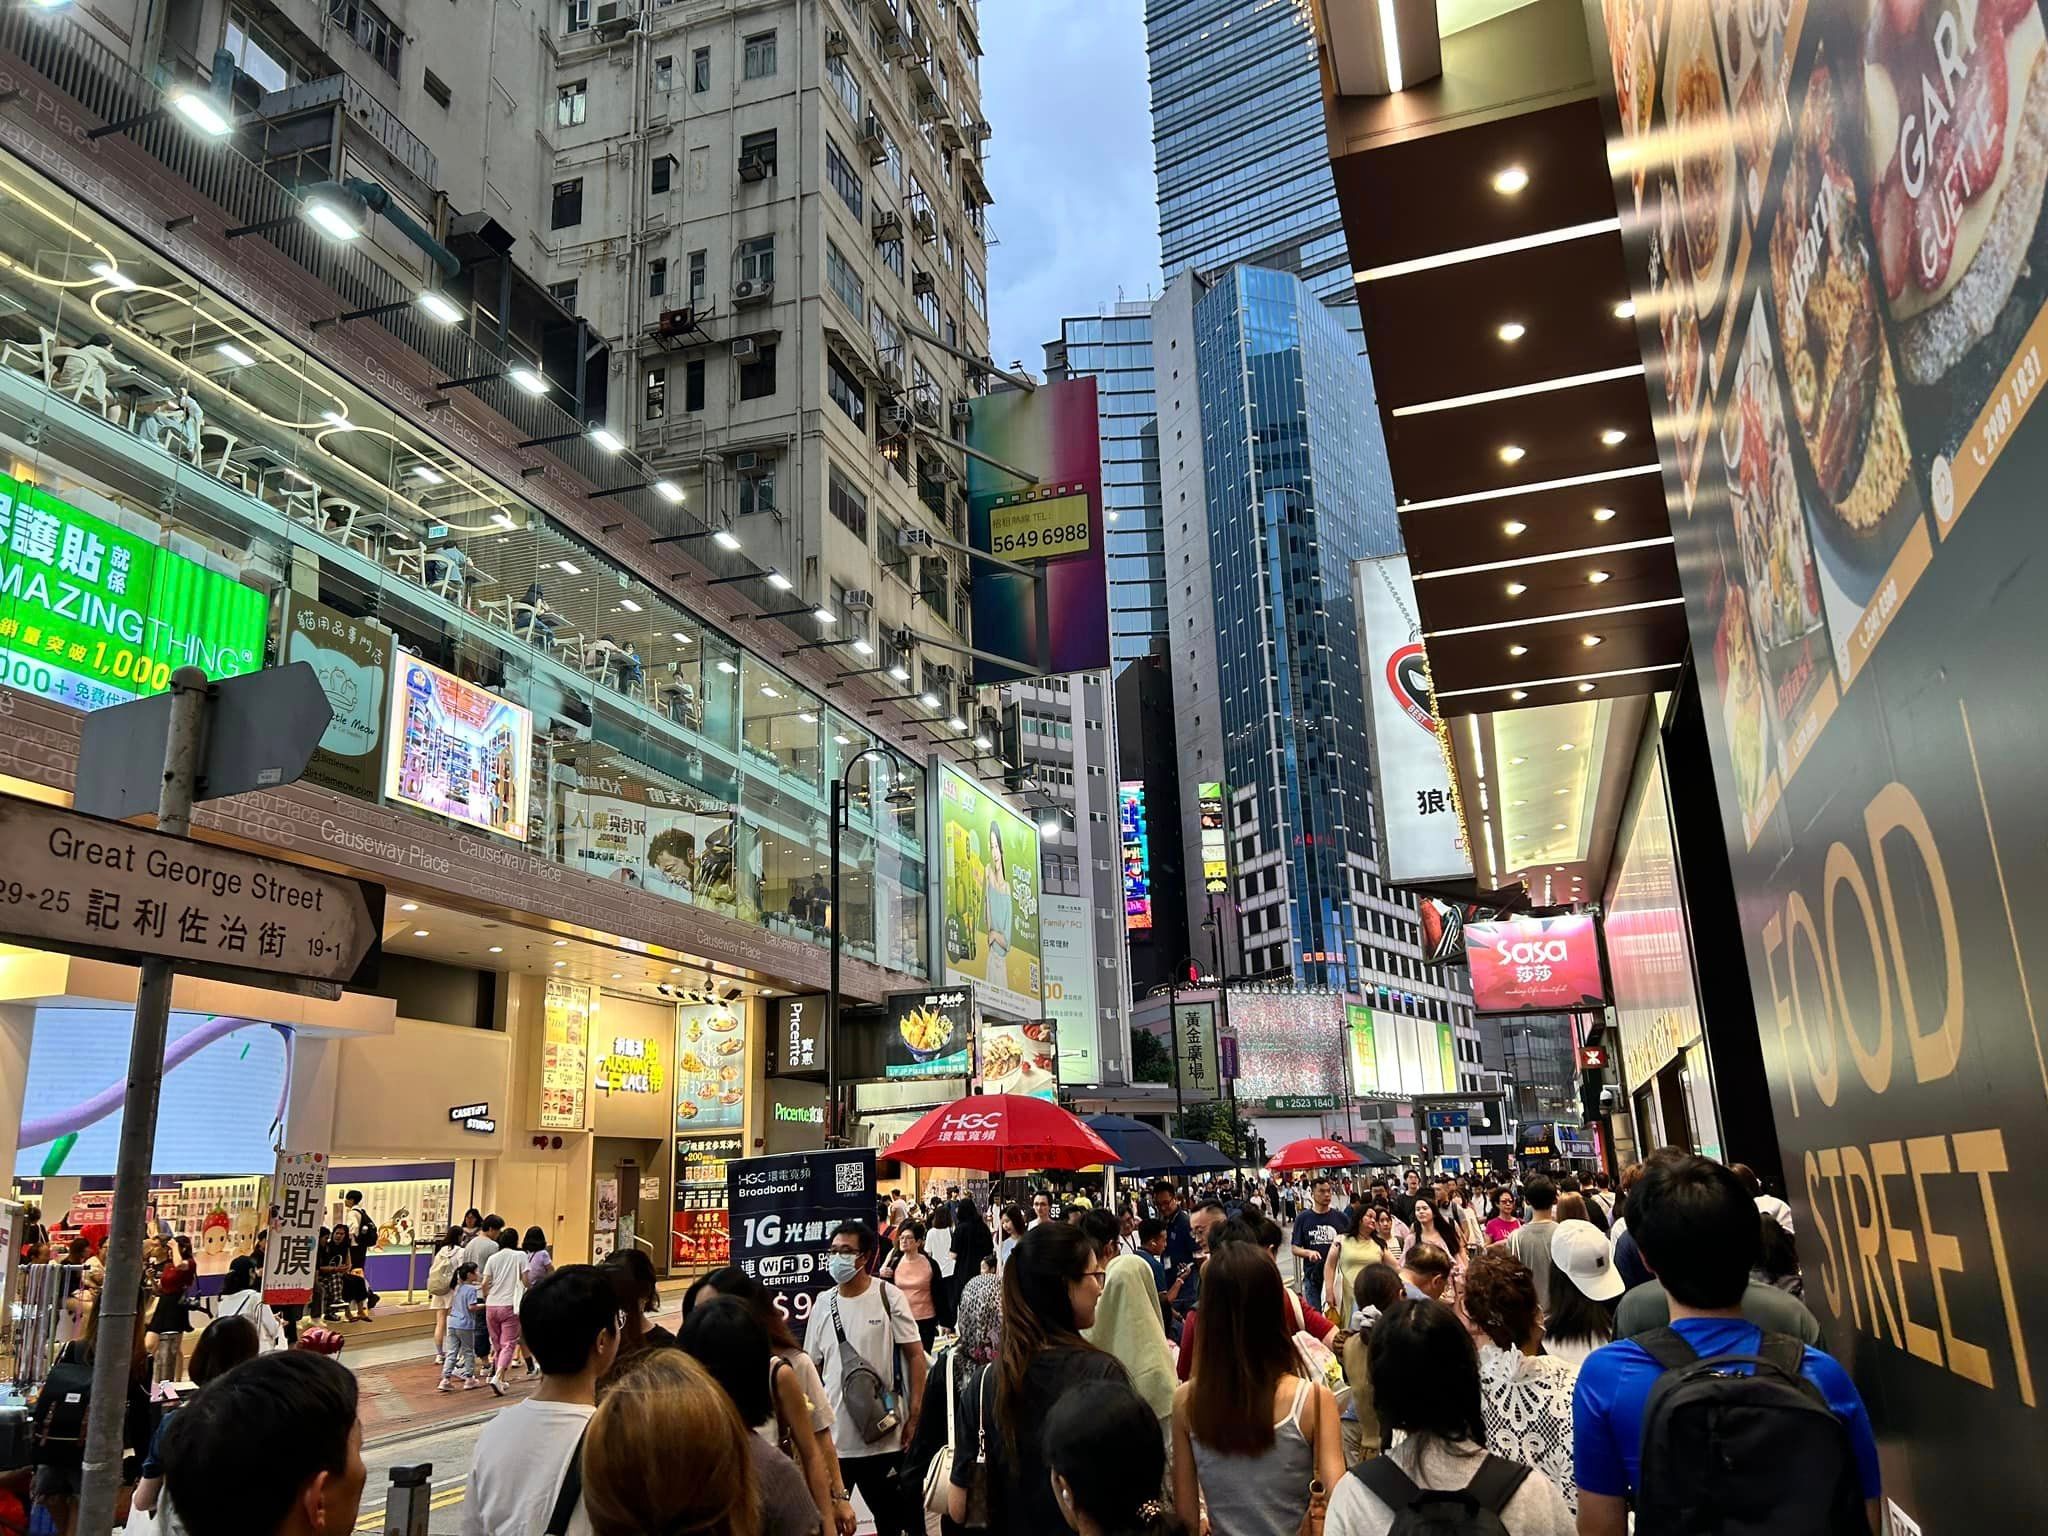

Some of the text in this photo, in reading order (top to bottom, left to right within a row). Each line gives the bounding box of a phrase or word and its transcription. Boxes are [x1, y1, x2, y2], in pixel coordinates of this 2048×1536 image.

[364, 356, 480, 448] Causeway Place
[549, 468, 582, 498] Place
[993, 523, 1087, 553] 5649 6988
[297, 609, 385, 665] 貓用品專門店
[351, 719, 376, 735] Meow
[1407, 704, 1428, 724] BEST
[276, 799, 320, 824] Place
[321, 819, 450, 875] Causeway Place
[458, 835, 526, 874] Causeway
[528, 856, 562, 882] Place
[49, 827, 324, 913] Great George Street
[85, 888, 287, 958] 記利佐治街
[696, 927, 762, 961] Causeway Place
[764, 930, 797, 953] Causeway
[1762, 782, 1965, 1119] FOOD
[1515, 964, 1553, 983] 莎莎
[790, 1003, 803, 1067] Pricerite
[1184, 1011, 1205, 1081] 黃金廣場
[1291, 1099, 1312, 1109] 2523
[1313, 1098, 1333, 1109] 1840
[938, 1130, 997, 1142] 環電寬頻
[942, 1112, 1003, 1130] HGC
[1315, 1145, 1340, 1154] HGC
[282, 1171, 325, 1189] 100%完美
[738, 1167, 812, 1186] HGC 環電寬頻
[738, 1183, 798, 1198] Broadband
[274, 1189, 319, 1276] 貼膜
[743, 1214, 782, 1248] 1G
[740, 1258, 756, 1278] 連
[762, 1274, 811, 1287] CERTIFIED
[1804, 1128, 2037, 1408] STREET
